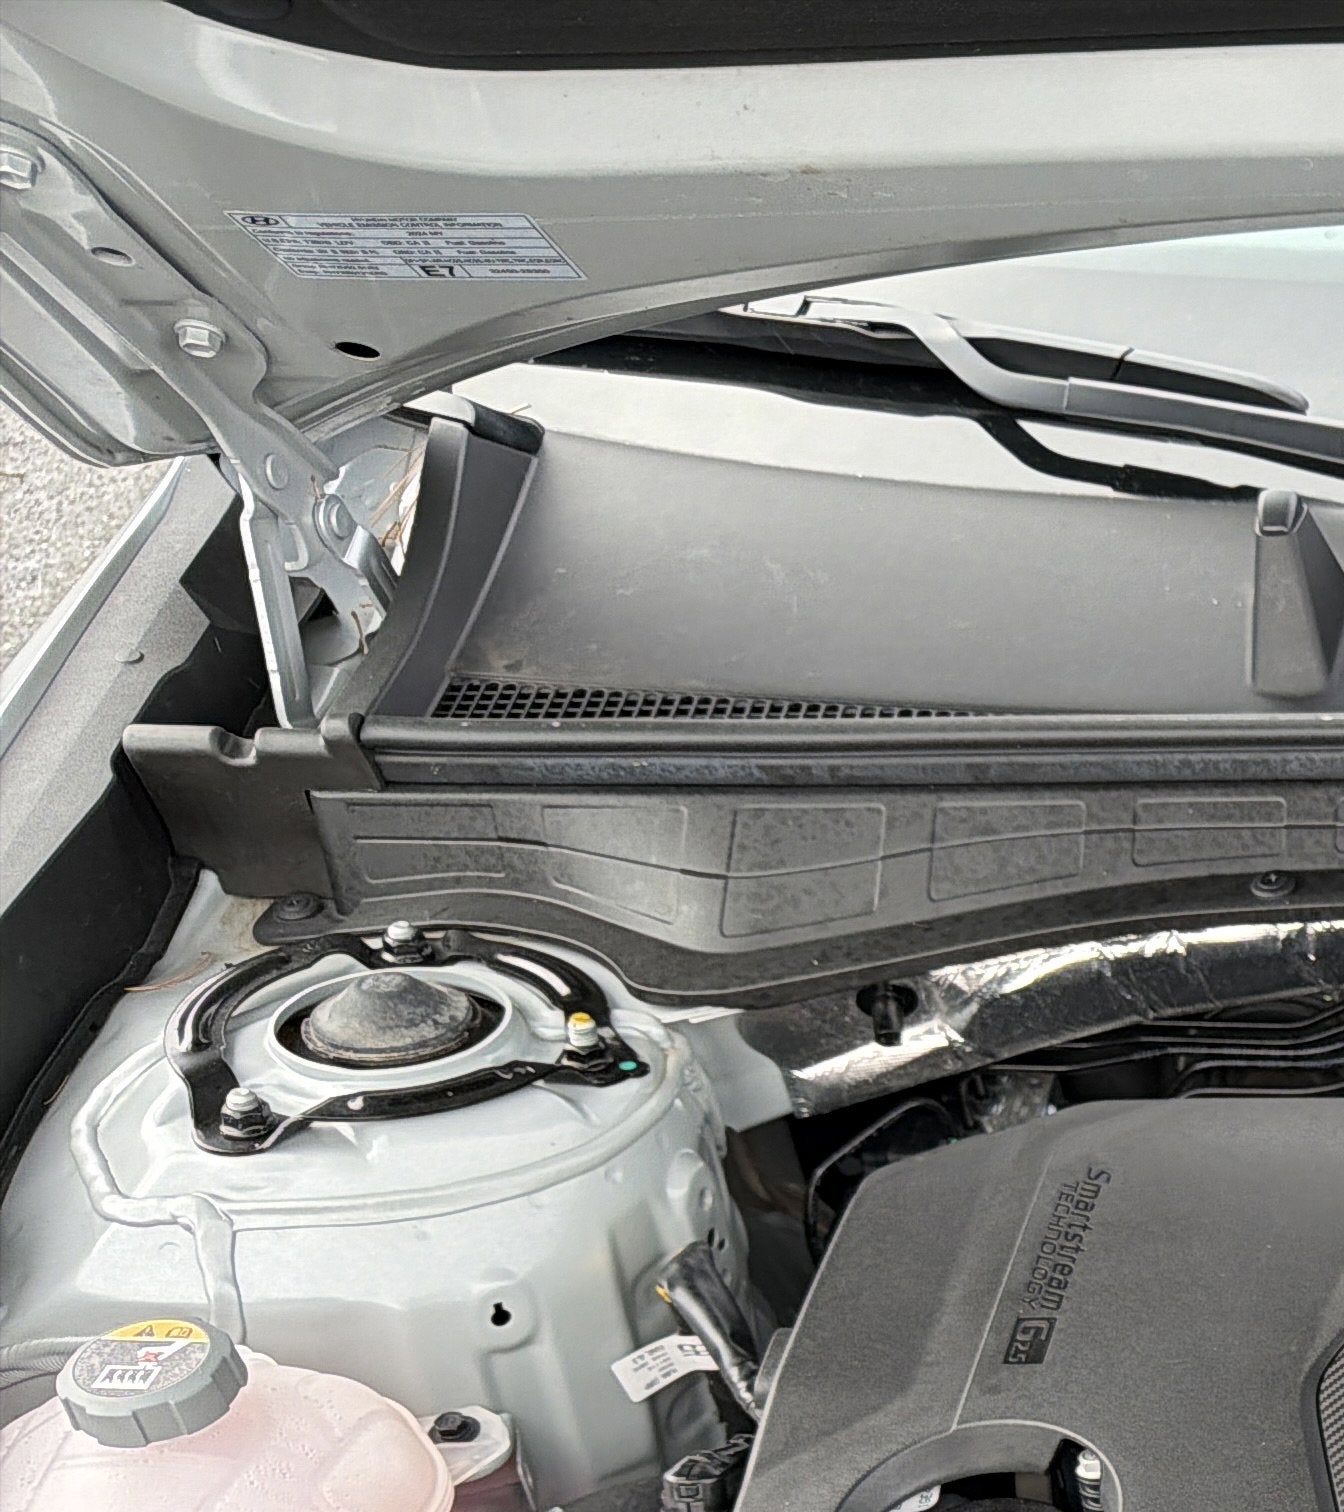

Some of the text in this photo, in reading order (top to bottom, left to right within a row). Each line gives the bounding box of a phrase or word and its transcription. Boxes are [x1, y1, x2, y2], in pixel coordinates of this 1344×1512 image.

[418, 265, 456, 277] E7
[1021, 1181, 1081, 1310] TECHNOLOGY
[1040, 1166, 1112, 1312] Smartstream
[1008, 1319, 1050, 1364] G25
